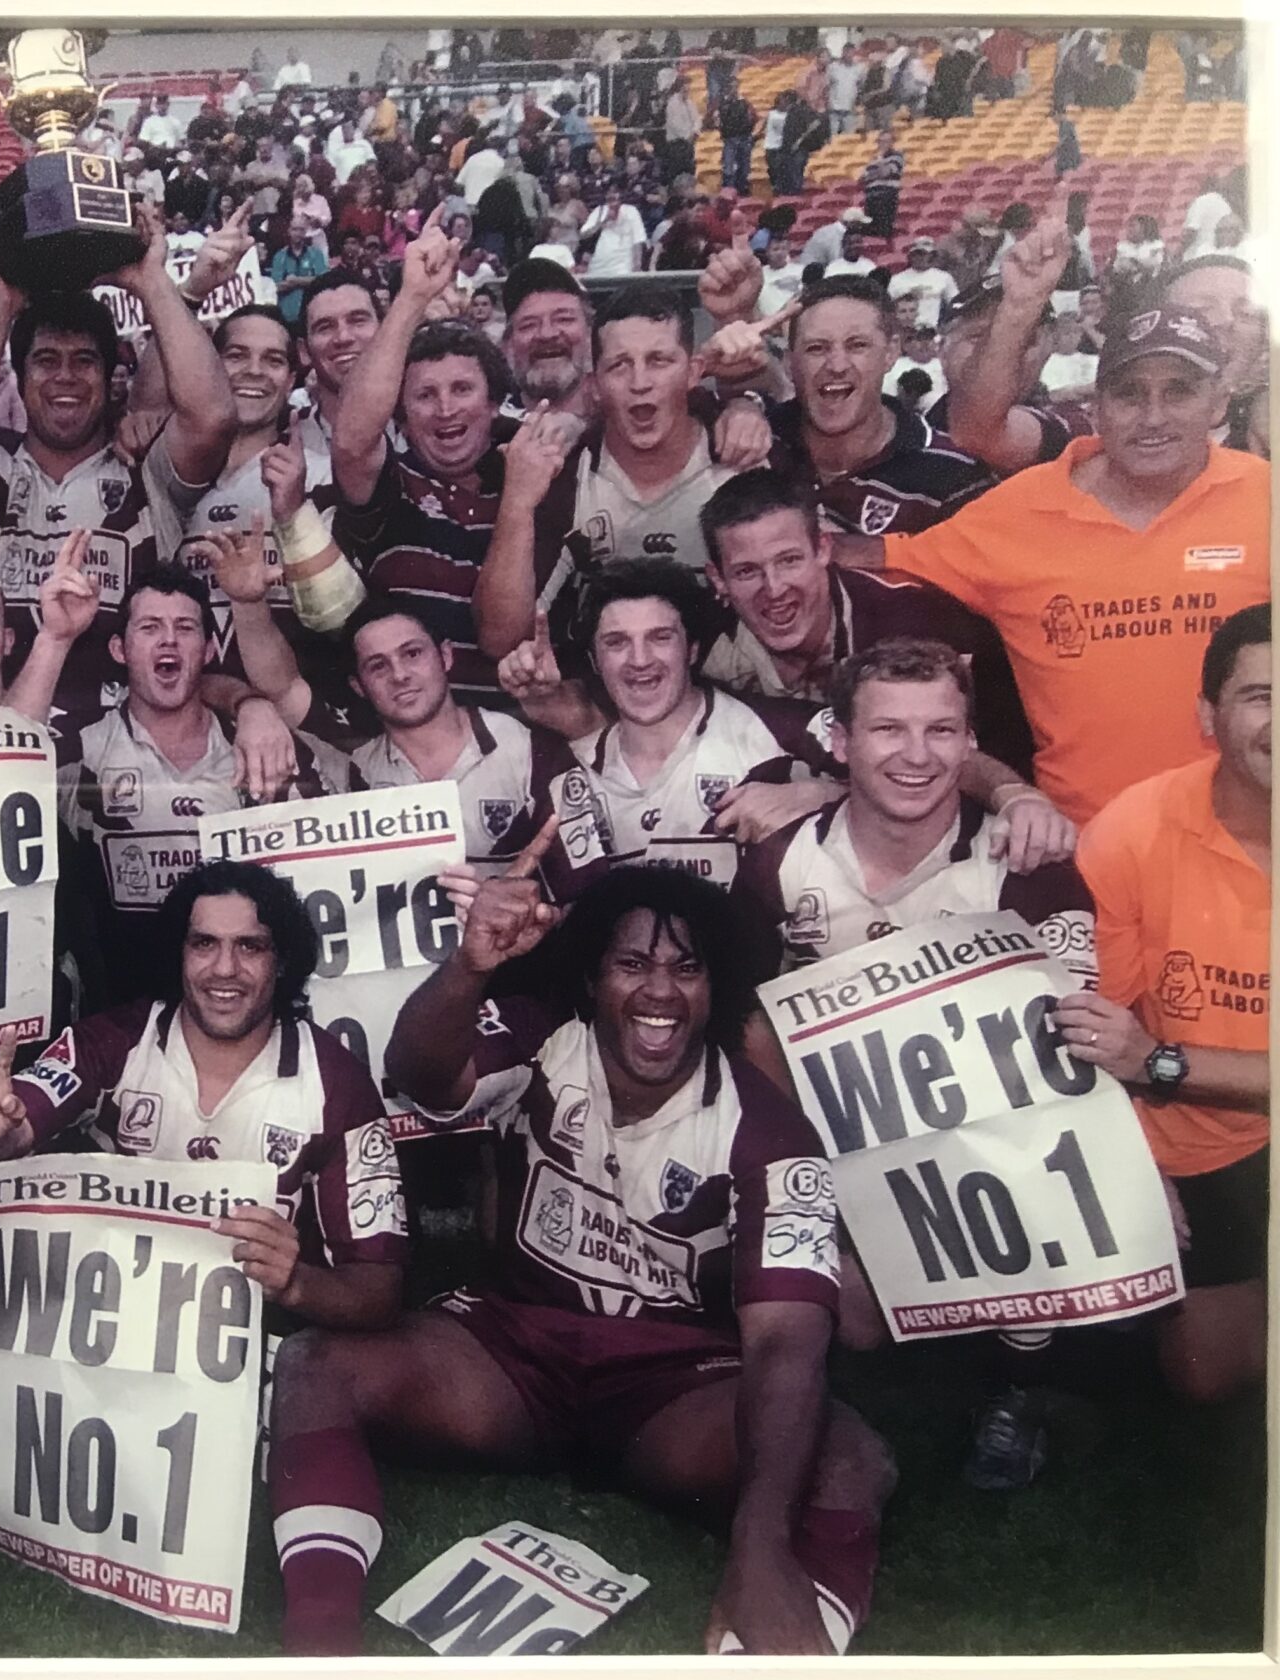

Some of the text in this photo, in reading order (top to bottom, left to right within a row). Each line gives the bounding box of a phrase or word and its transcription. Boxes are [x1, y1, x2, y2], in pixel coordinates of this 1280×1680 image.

[1081, 592, 1217, 619] TRADES AND
[1090, 615, 1223, 641] LABOUR HIR
[149, 849, 202, 868] TRADE
[211, 805, 450, 859] The Bulletin
[276, 868, 460, 979] e're
[777, 928, 1036, 1026] The Bulletin
[800, 994, 1097, 1156] We're
[884, 1129, 1119, 1283] No.1
[900, 1270, 1173, 1329] NEWSPAPER OF THE YEAR
[14, 1385, 198, 1556] No.1
[502, 1529, 581, 1584] The
[99, 1562, 123, 1586] OF
[125, 1572, 162, 1603] THE
[165, 1583, 228, 1617] YEAR
